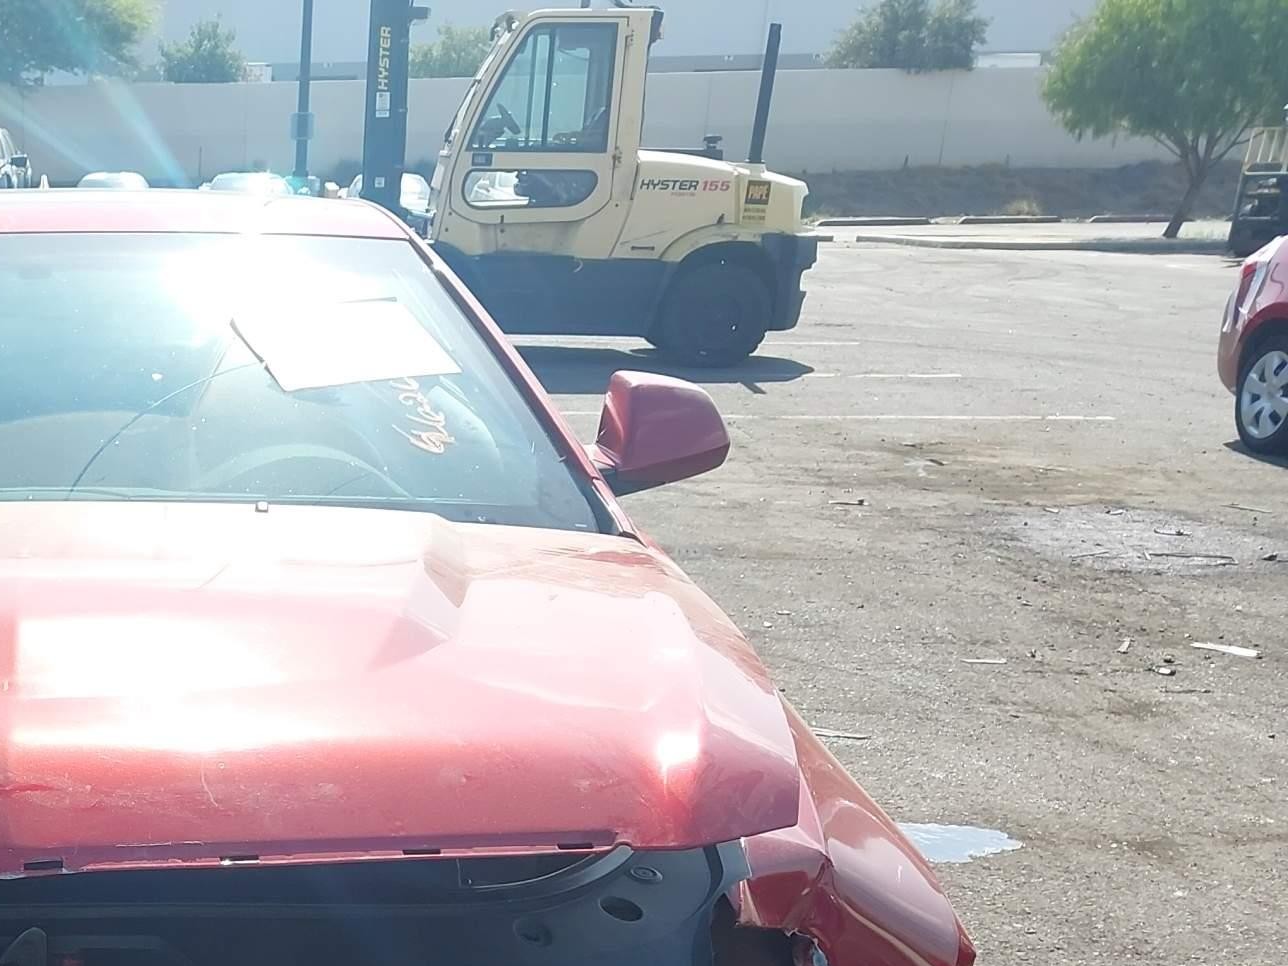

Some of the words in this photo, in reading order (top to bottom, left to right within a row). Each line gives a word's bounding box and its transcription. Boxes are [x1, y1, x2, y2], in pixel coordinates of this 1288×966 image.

[378, 26, 392, 90] HYSTER
[640, 179, 700, 191] HYSTER
[702, 180, 731, 192] 155
